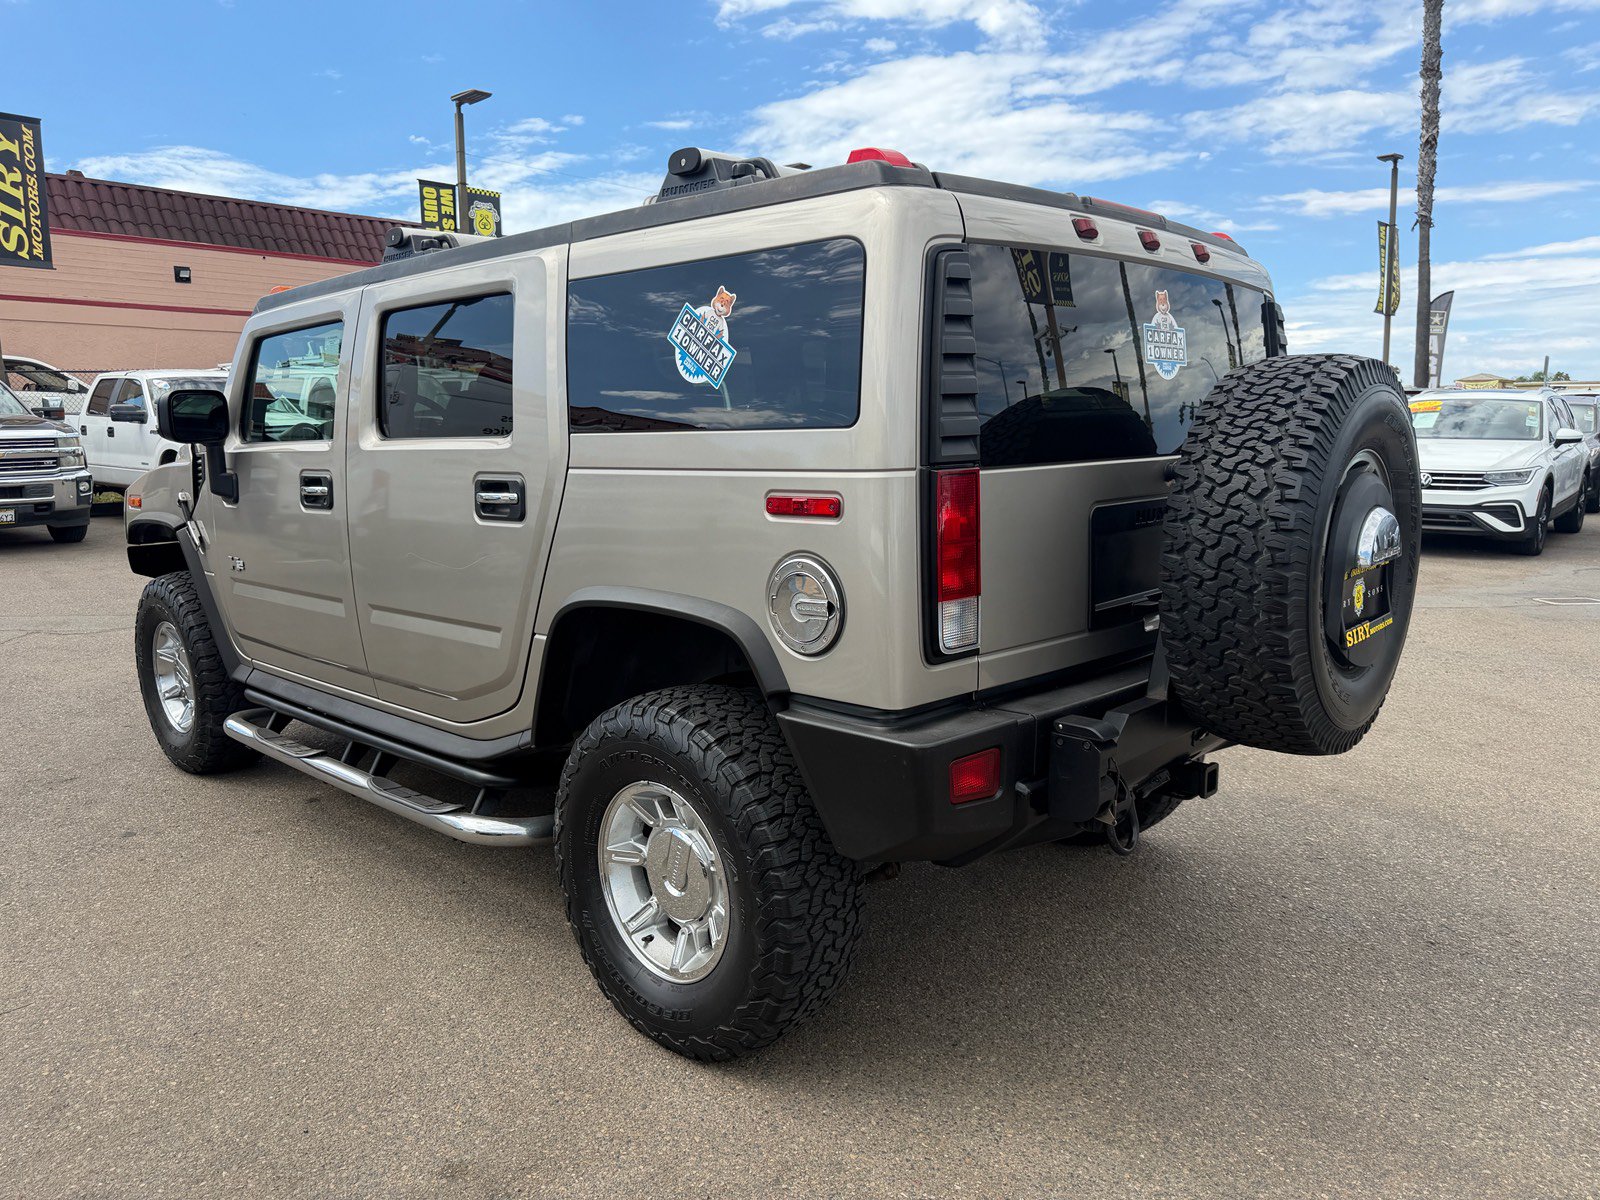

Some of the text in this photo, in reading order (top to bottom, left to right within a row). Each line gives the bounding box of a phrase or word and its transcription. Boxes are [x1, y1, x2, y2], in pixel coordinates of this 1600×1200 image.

[0, 133, 30, 260] SIRY
[21, 123, 44, 261] MOTORS.COM
[422, 186, 439, 223] OUR
[439, 189, 454, 216] WE
[661, 178, 717, 198] HUMMER
[674, 328, 683, 340] 1
[681, 337, 721, 380] OWNER
[682, 313, 728, 366] CARFAX
[1147, 330, 1185, 347] CARFAX
[1148, 346, 1185, 360] 1 OWNER
